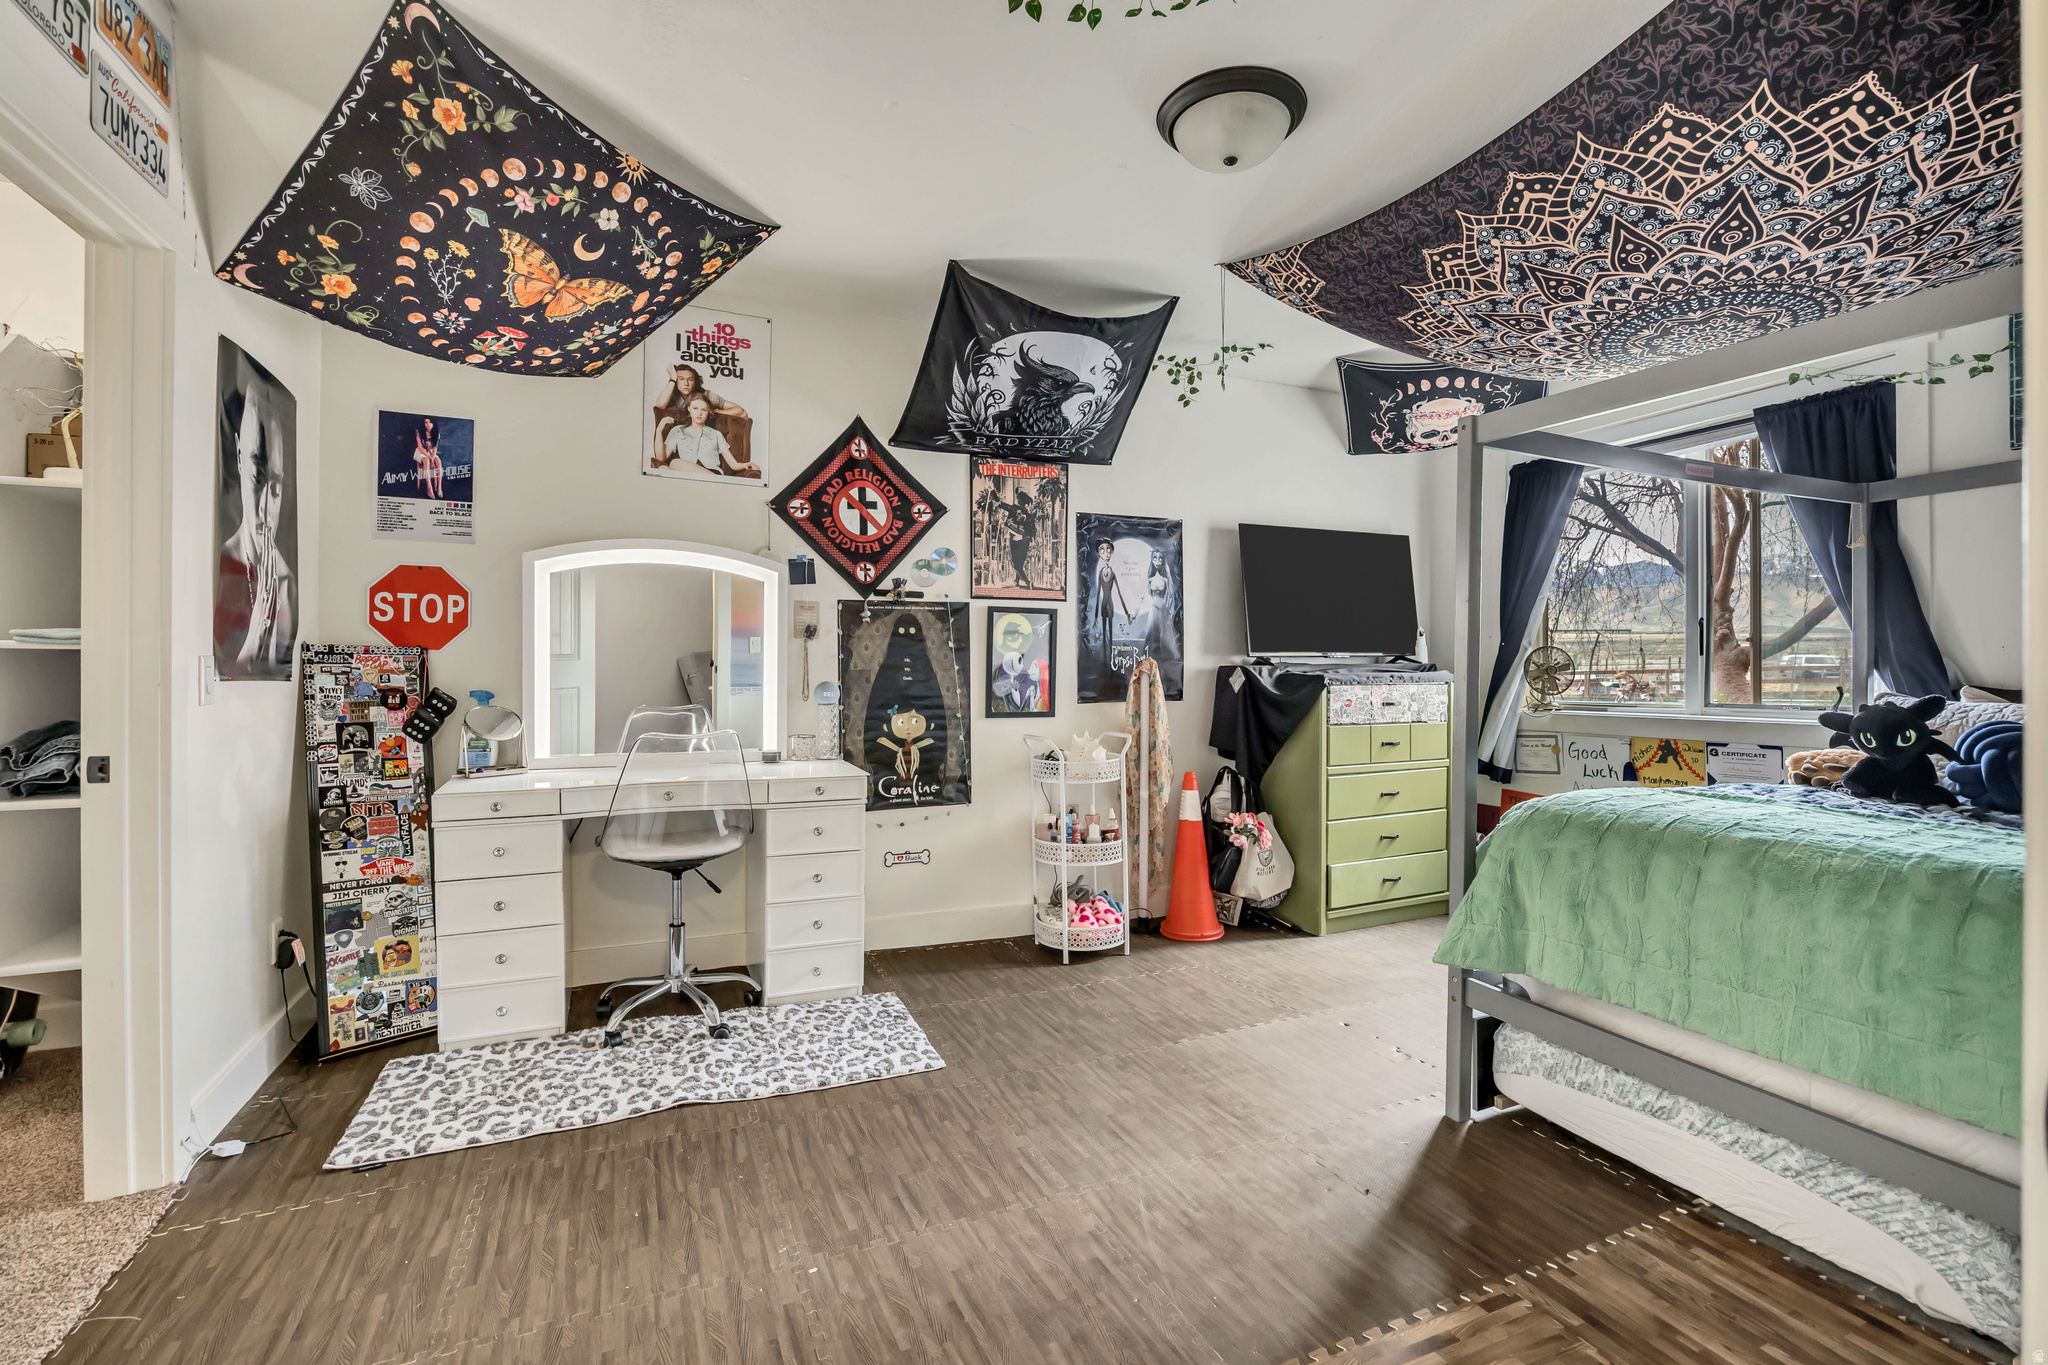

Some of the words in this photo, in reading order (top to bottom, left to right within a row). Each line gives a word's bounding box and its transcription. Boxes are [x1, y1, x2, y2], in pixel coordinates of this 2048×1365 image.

[97, 61, 111, 81] AUG
[111, 77, 159, 137] California
[99, 85, 167, 184] 7UMY334
[685, 325, 751, 350] things
[714, 322, 735, 336] 10
[676, 333, 681, 351] I
[686, 335, 730, 356] hate
[680, 350, 739, 367] about
[709, 365, 744, 380] you
[976, 436, 1019, 447] BAD
[1024, 438, 1073, 450] YEAR
[381, 471, 408, 484] AMY
[980, 464, 996, 476] THE
[998, 464, 1059, 478] INTERRUPTERS
[822, 478, 844, 504] BAD
[844, 468, 902, 506] RELIGION
[822, 517, 881, 554] RELIGION
[882, 518, 904, 544] BAD
[373, 592, 465, 624] STOP
[1568, 742, 1608, 761] Good
[1583, 764, 1619, 781] Luck
[1643, 776, 1674, 787] Mayhem
[878, 775, 940, 806] Coraline
[401, 814, 411, 856] CLAYFACE
[380, 866, 392, 875] THE
[329, 880, 357, 890] NEVER
[359, 876, 392, 886] FORGET
[332, 892, 350, 900] JIM
[352, 886, 392, 897] CHERRY
[394, 926, 419, 936] SIGNAL
